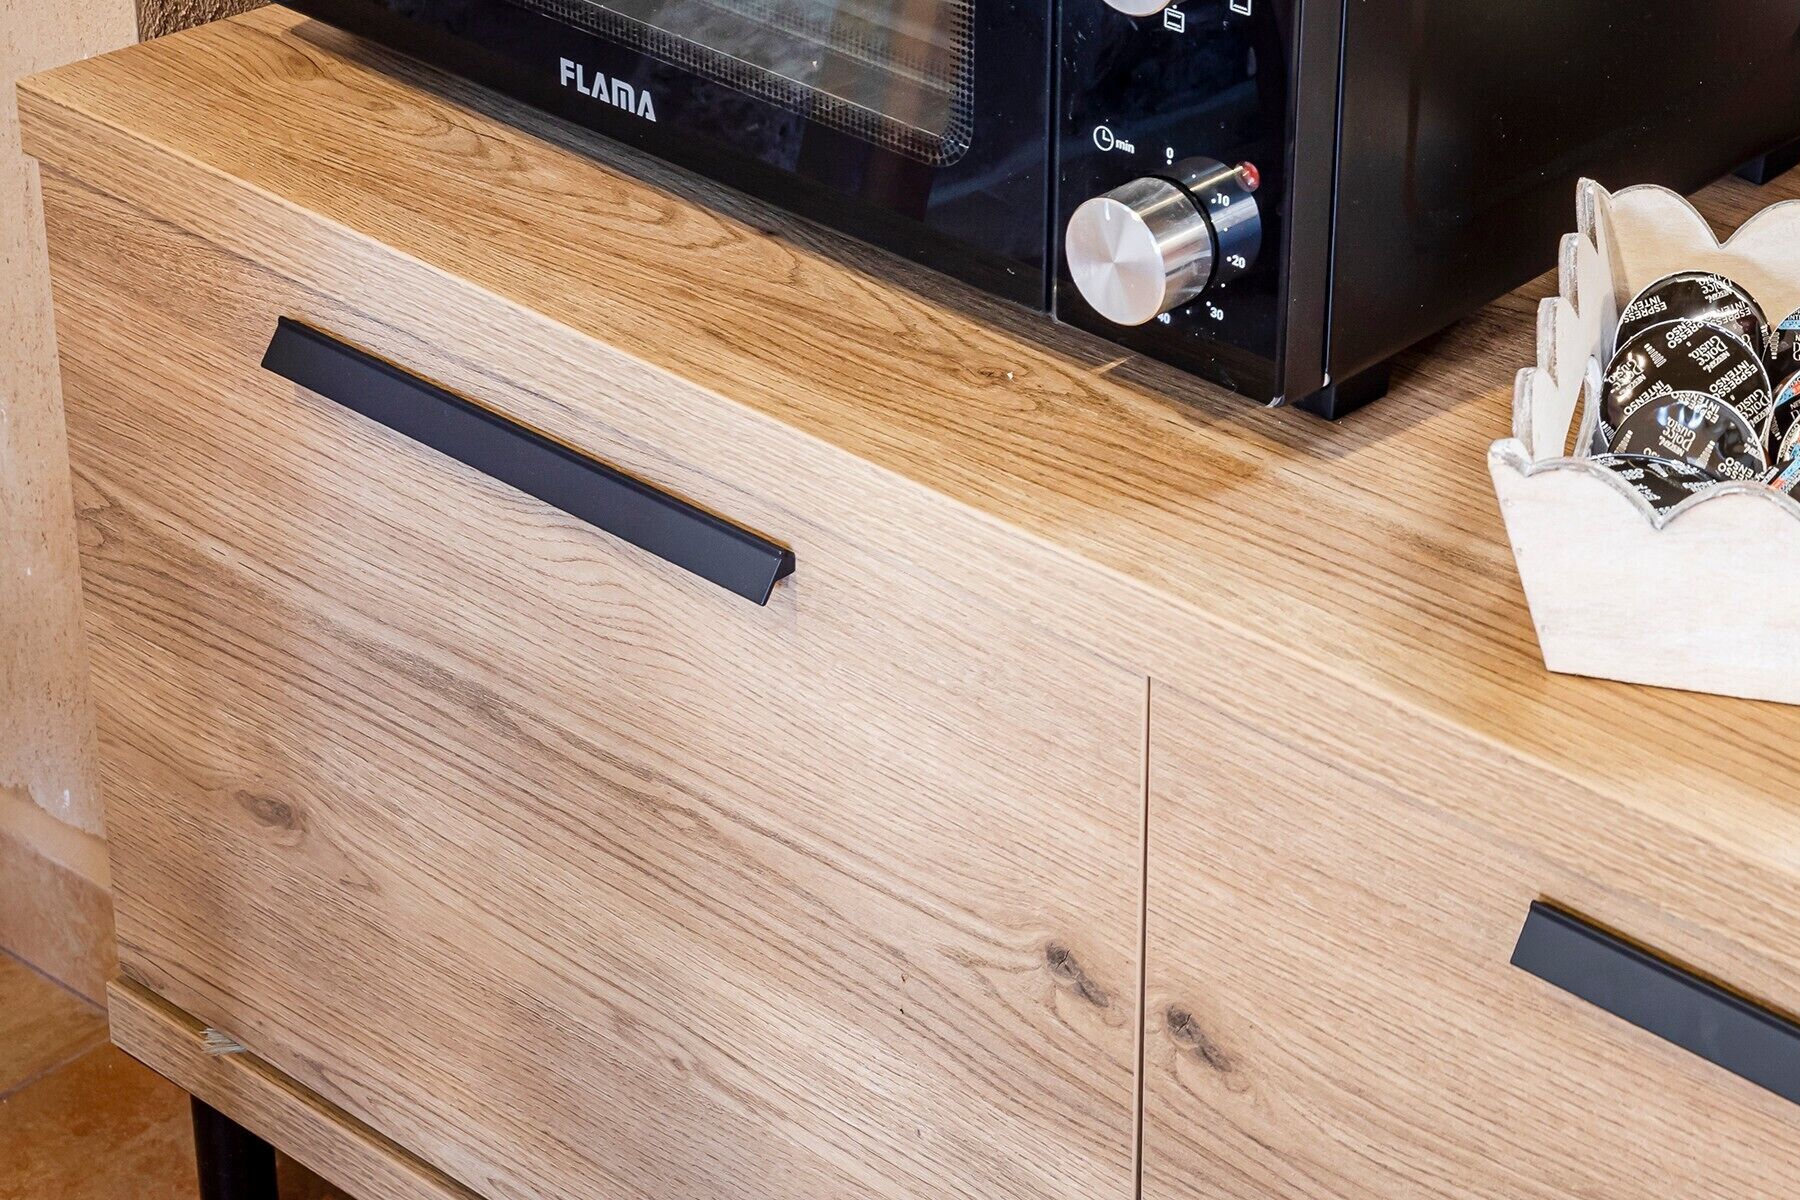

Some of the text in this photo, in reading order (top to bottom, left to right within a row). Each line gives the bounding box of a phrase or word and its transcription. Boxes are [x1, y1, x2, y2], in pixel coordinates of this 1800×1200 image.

[560, 56, 657, 122] FLAMA
[1115, 138, 1135, 154] min
[1166, 147, 1174, 159] 0
[1216, 193, 1230, 207] 10
[1231, 255, 1246, 269] 20
[1210, 306, 1224, 320] 30
[1709, 360, 1750, 393] INTENSO
[1623, 380, 1665, 416] INTENSO
